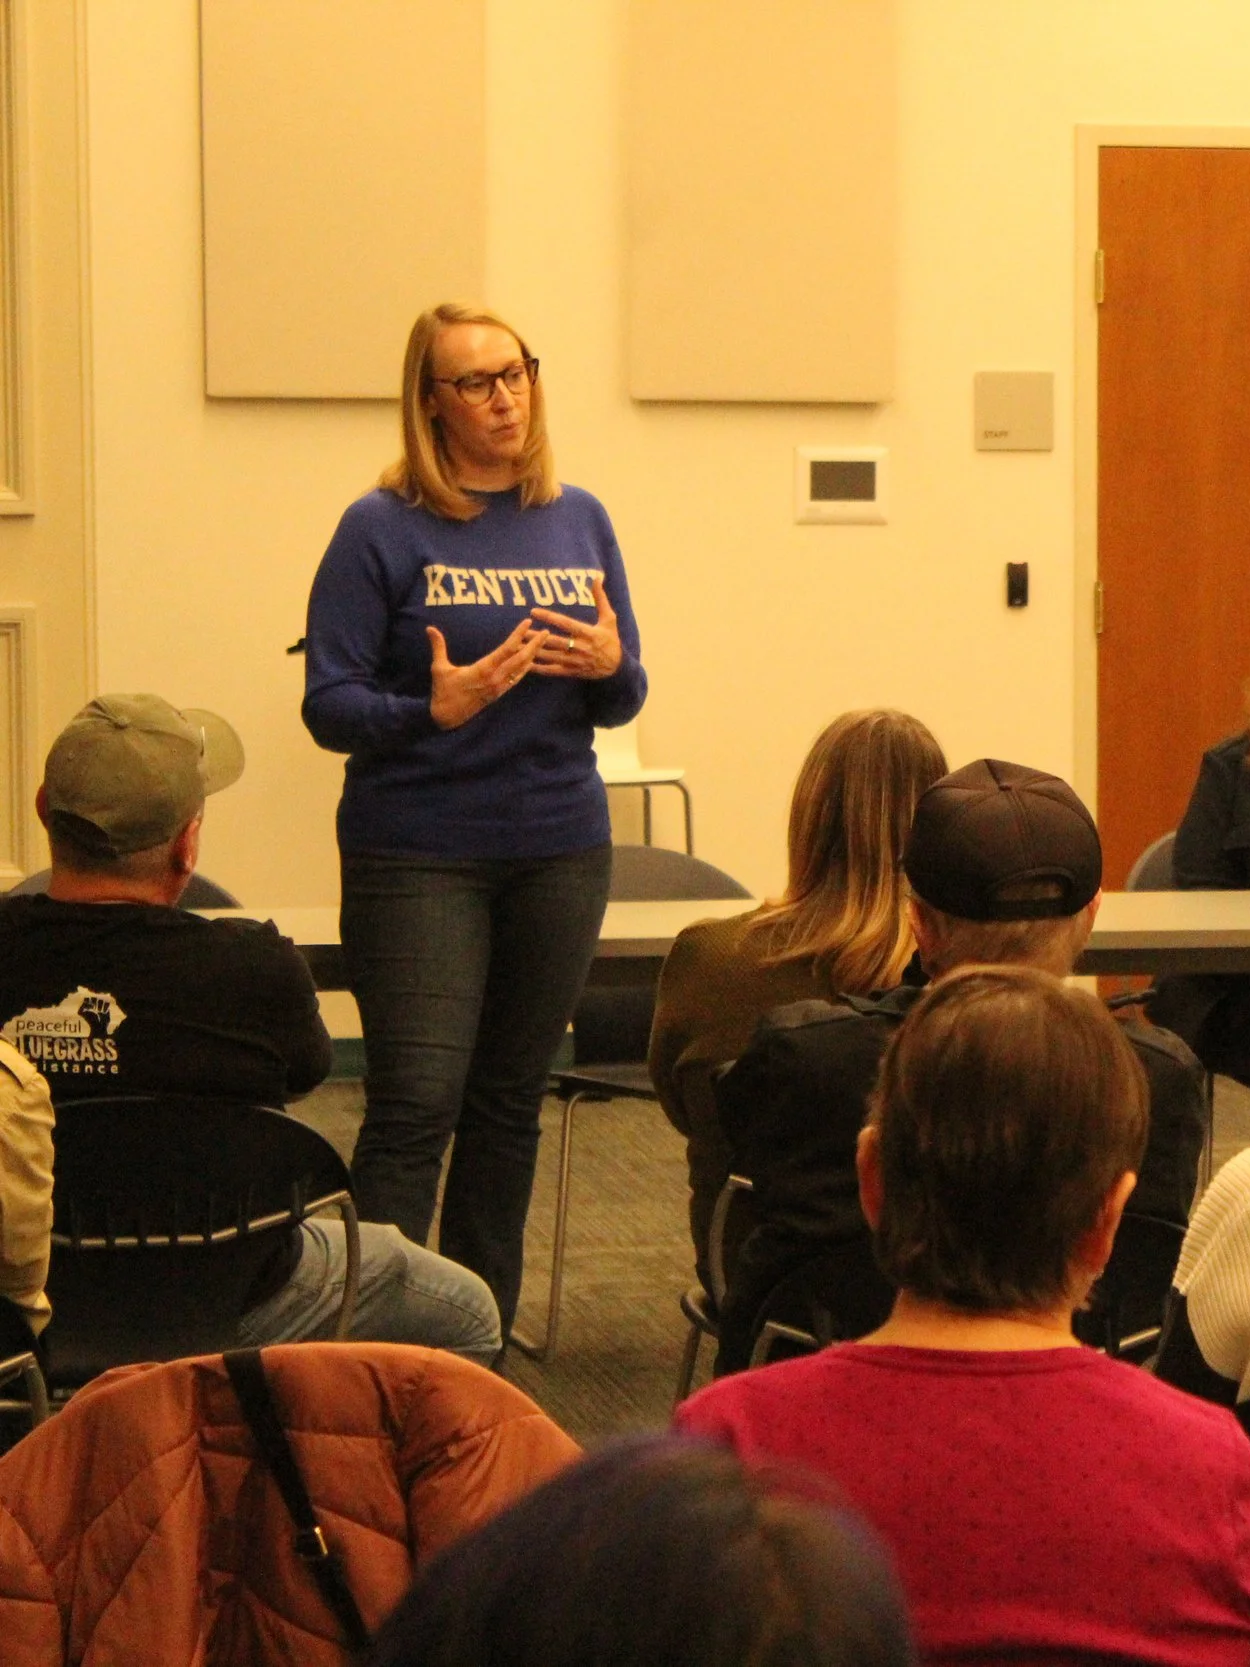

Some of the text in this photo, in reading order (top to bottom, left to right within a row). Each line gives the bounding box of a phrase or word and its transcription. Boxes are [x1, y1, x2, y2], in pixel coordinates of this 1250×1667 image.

[16, 1019, 82, 1034] peaceful
[12, 1035, 118, 1061] LUEGRASS
[32, 1060, 119, 1075] istance
